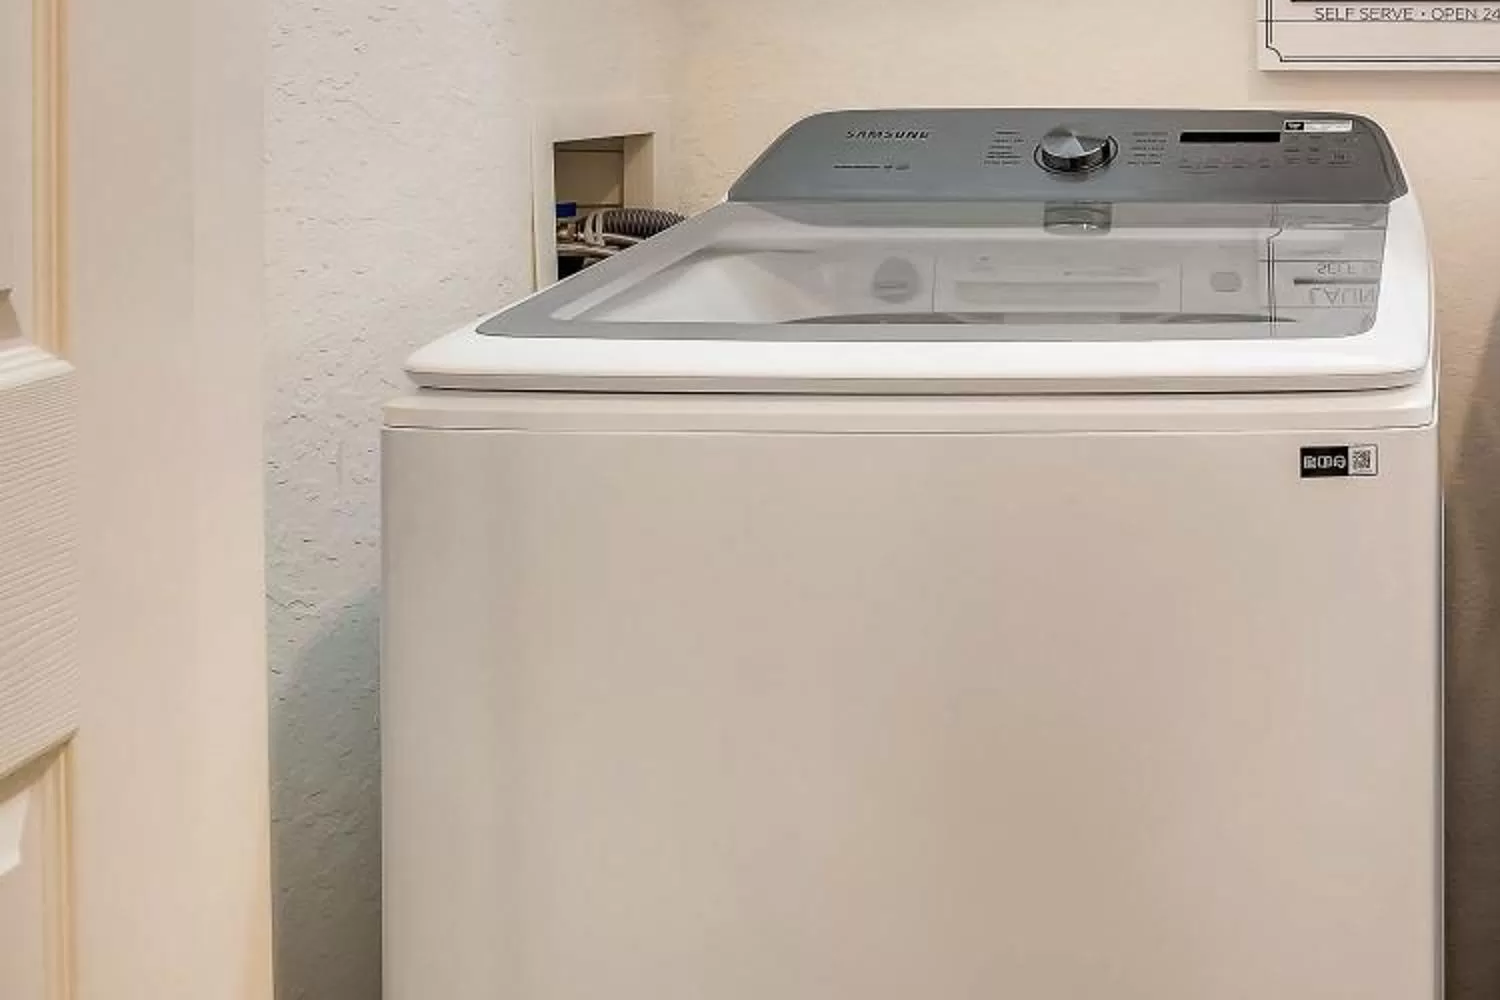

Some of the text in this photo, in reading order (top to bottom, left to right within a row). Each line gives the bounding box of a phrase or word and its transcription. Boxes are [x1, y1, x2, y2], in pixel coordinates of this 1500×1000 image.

[1315, 7, 1354, 21] SELF
[1359, 7, 1413, 22] SERVE
[1431, 7, 1477, 22] OPEN
[846, 130, 929, 139] SAMSUNG
